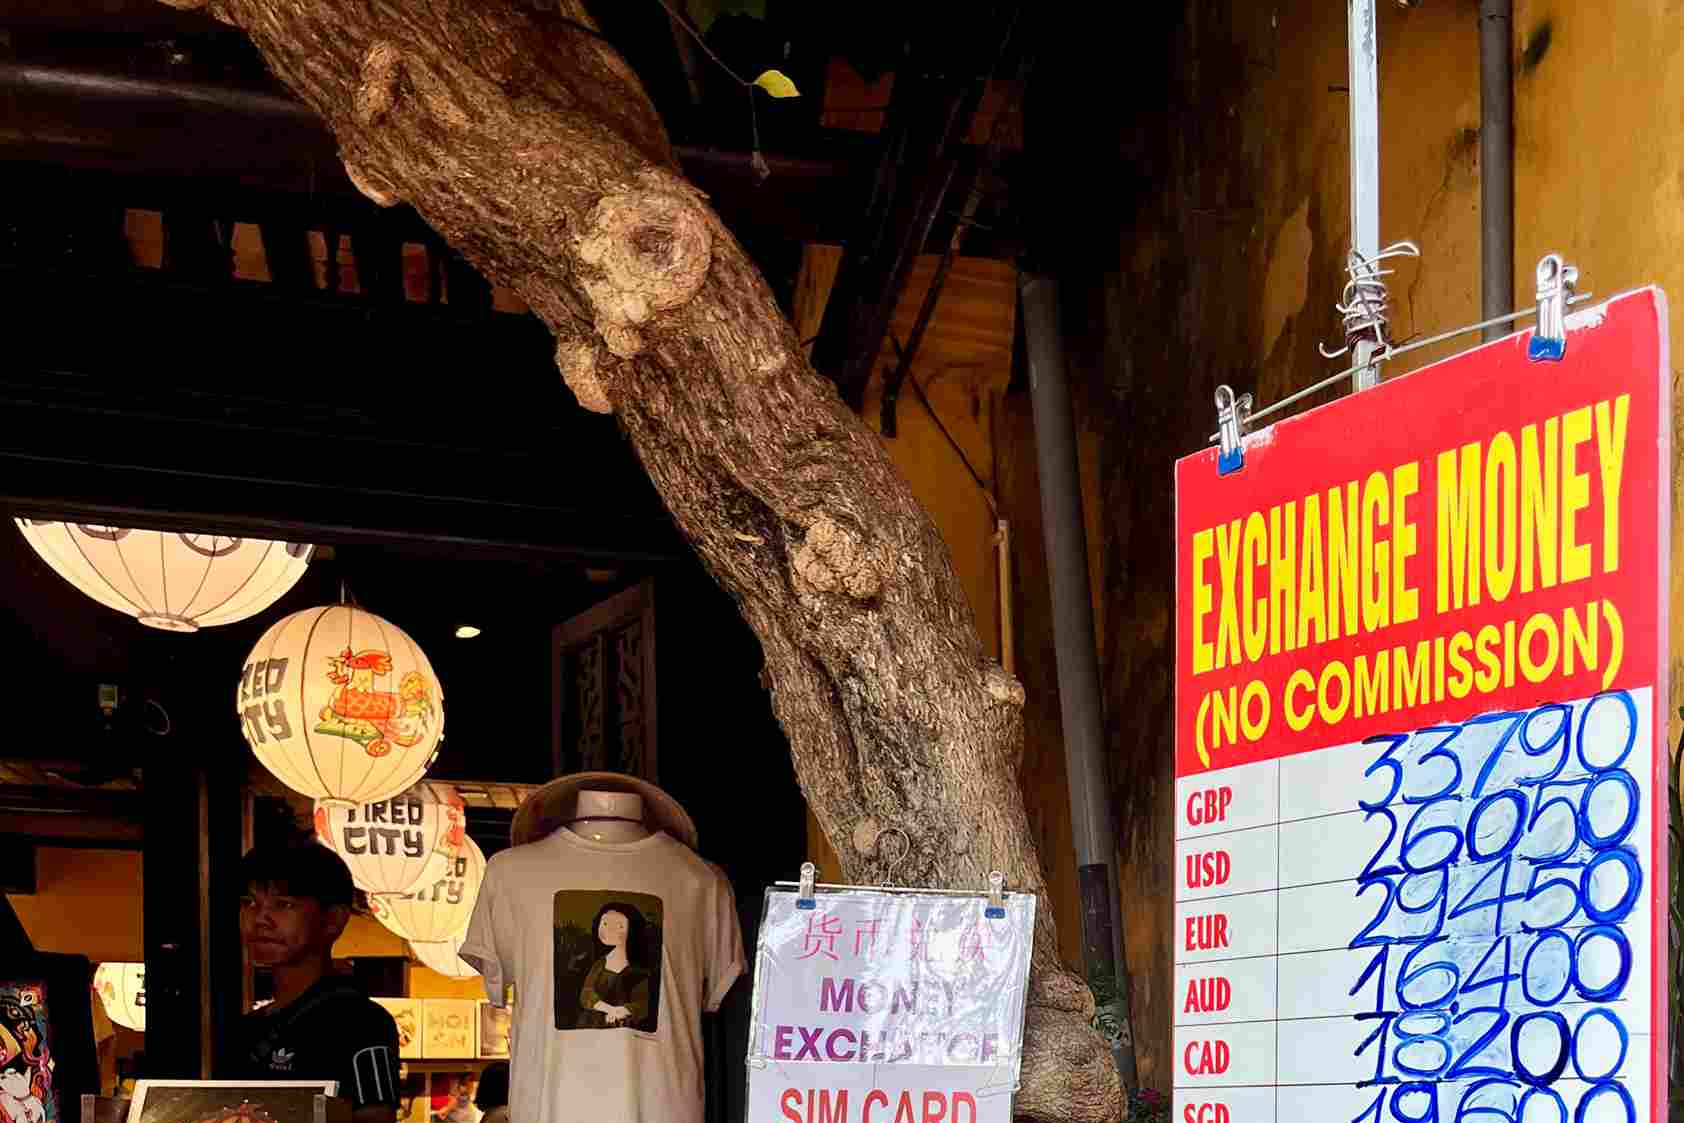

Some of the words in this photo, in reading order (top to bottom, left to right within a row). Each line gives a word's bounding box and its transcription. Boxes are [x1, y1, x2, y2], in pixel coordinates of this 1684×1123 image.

[1192, 460, 1419, 676] EXCHANGE
[1436, 393, 1631, 615] MONEY
[1195, 680, 1271, 769] (NO
[1283, 598, 1625, 733] COMMISSION)
[1358, 689, 1638, 811] 33790
[1185, 786, 1233, 827] GBP
[1359, 767, 1641, 883] 26050
[343, 826, 424, 858] CITY
[1185, 850, 1232, 889] USD
[1349, 844, 1643, 949] 29450
[1184, 913, 1230, 953] EUR
[1183, 976, 1232, 1014] AUD
[774, 1024, 1000, 1063] EXCHGE
[1183, 1040, 1231, 1076] CAD
[1353, 1006, 1629, 1087] 18200
